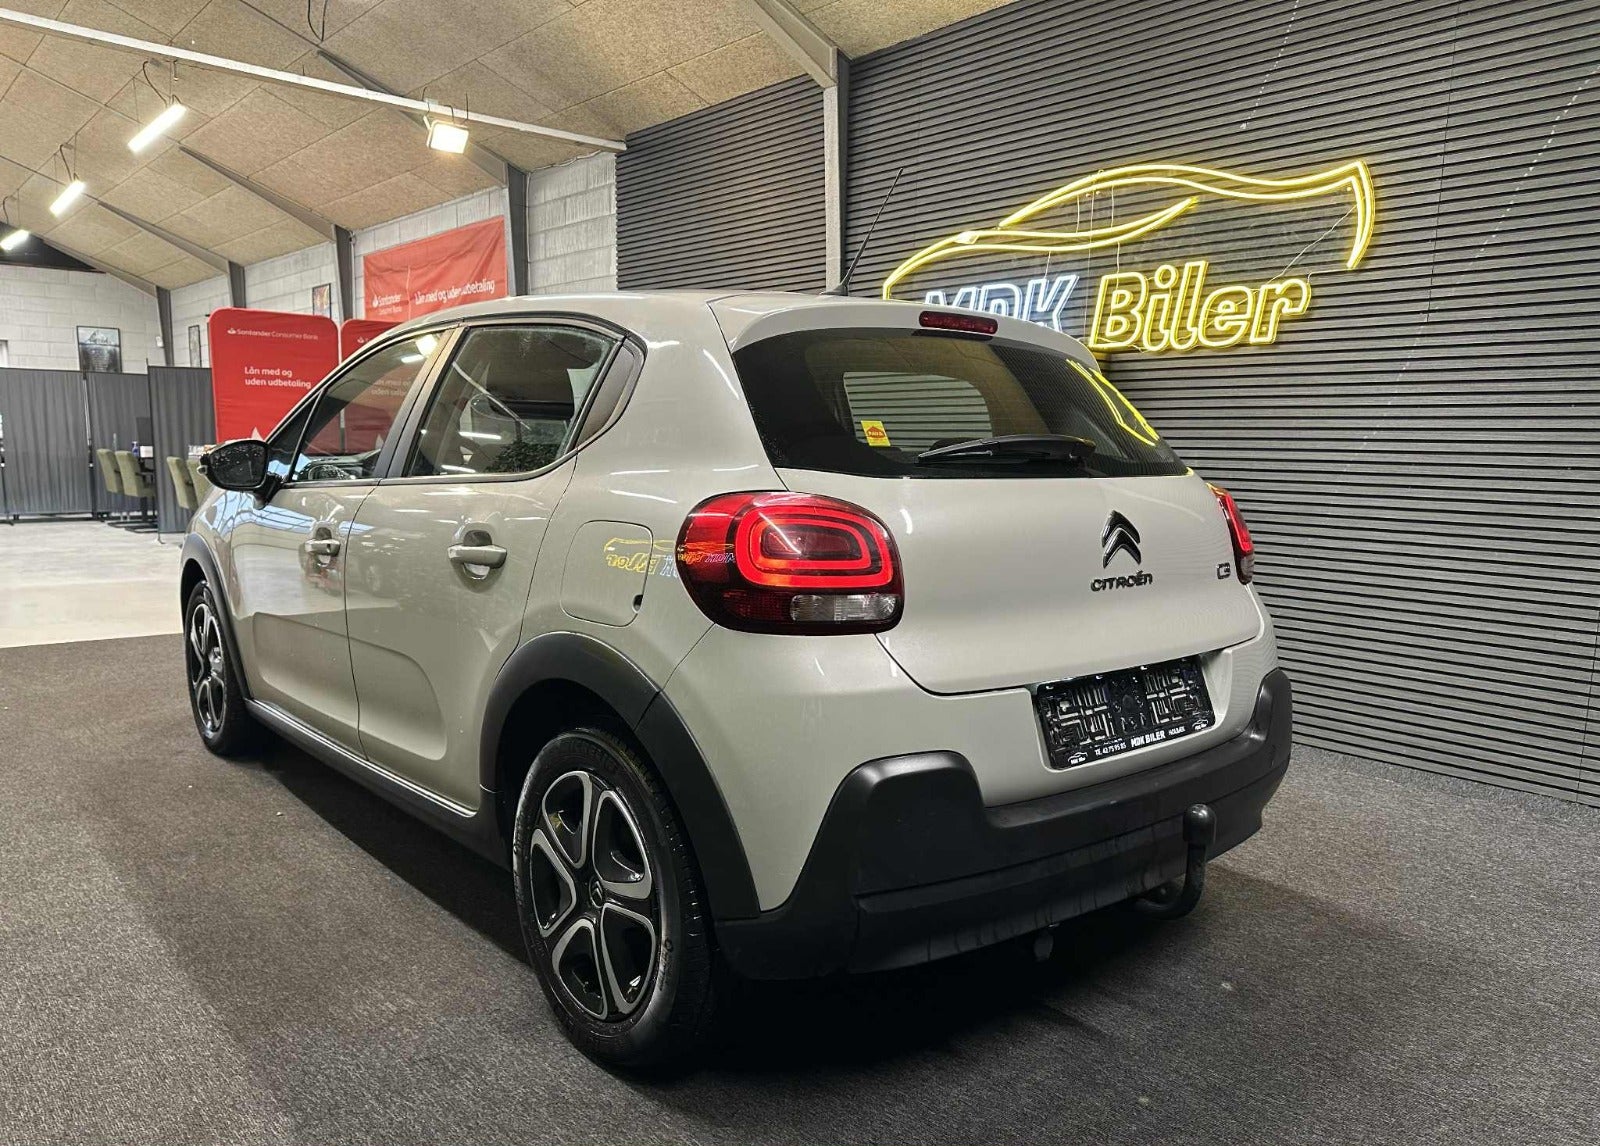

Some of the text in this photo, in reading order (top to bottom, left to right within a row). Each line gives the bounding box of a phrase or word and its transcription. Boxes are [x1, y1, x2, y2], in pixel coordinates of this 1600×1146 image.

[378, 294, 401, 306] Santander
[438, 289, 447, 303] og
[1088, 260, 1311, 351] Biler
[237, 328, 271, 337] Santander
[271, 331, 302, 339] Consumer
[244, 366, 293, 378] Lån med og
[245, 378, 311, 389] uden udbetaling
[1216, 562, 1231, 580] C3
[1130, 735, 1145, 747] MDK
[1145, 730, 1166, 743] BILER
